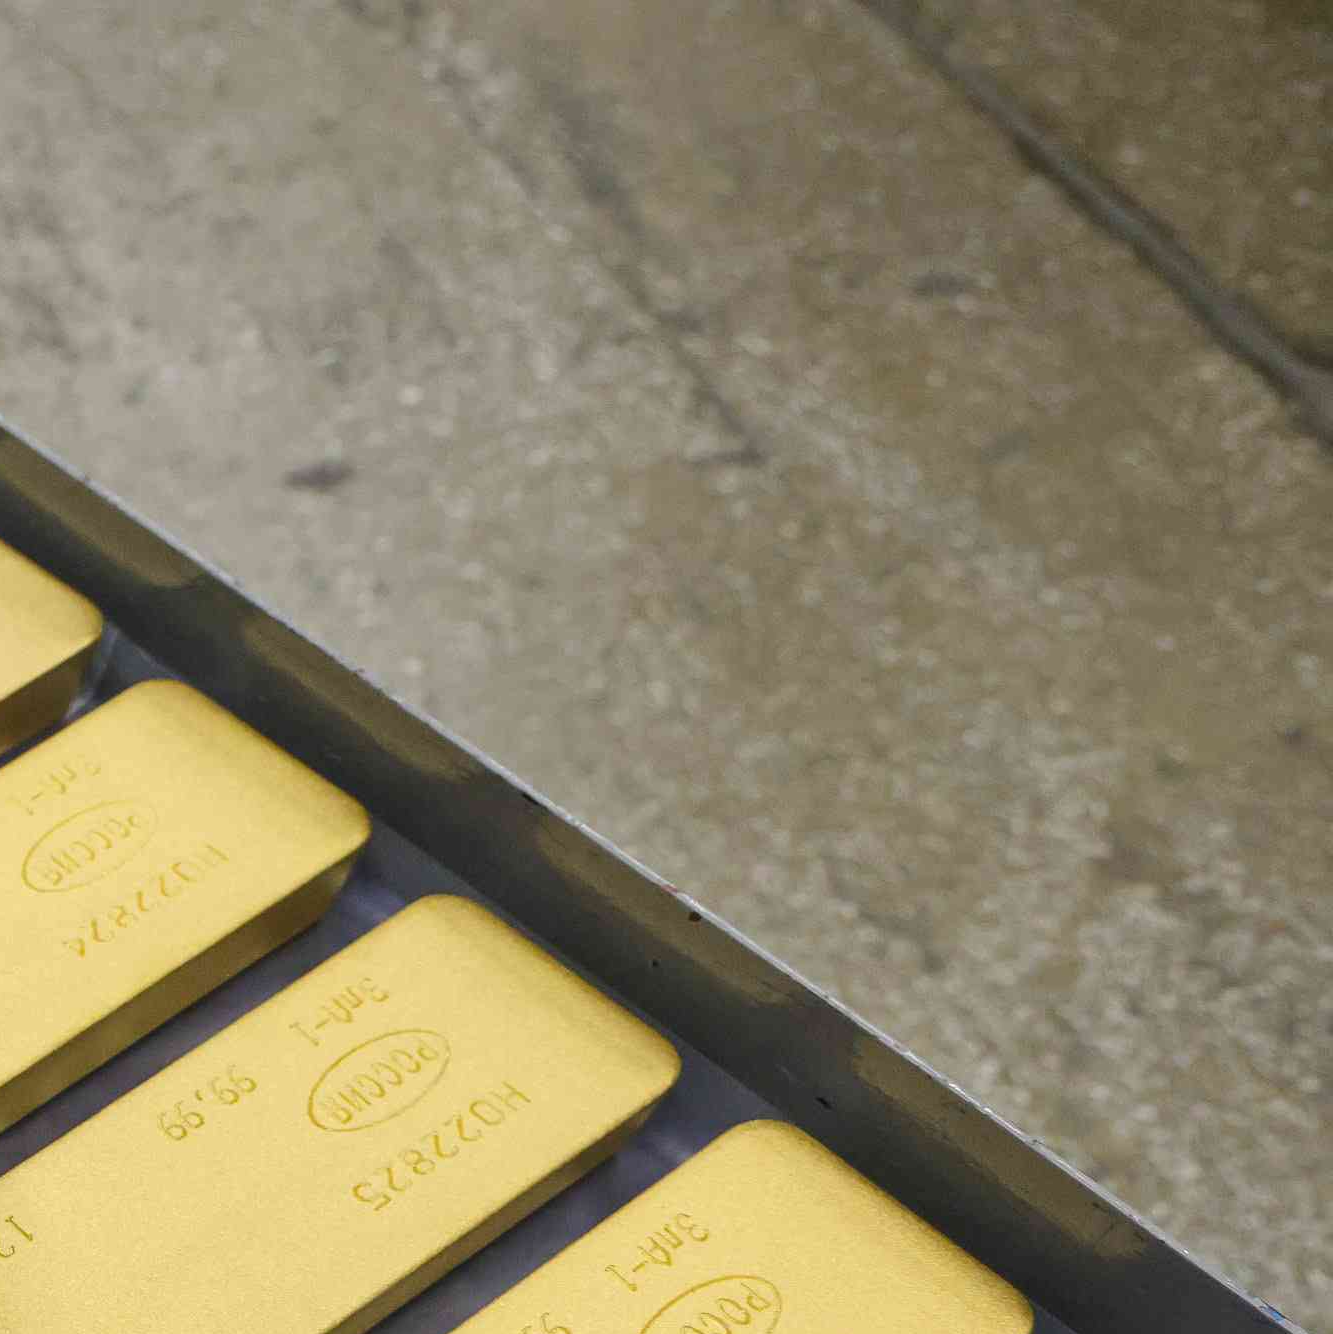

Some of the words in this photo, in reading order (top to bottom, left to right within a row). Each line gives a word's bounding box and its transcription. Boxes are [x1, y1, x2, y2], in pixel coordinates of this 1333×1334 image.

[36, 805, 143, 891] РОССИЯ
[151, 1062, 258, 1146] 99,99
[320, 1034, 439, 1130] РОССИЯ
[601, 1209, 711, 1295] ЗлА-1
